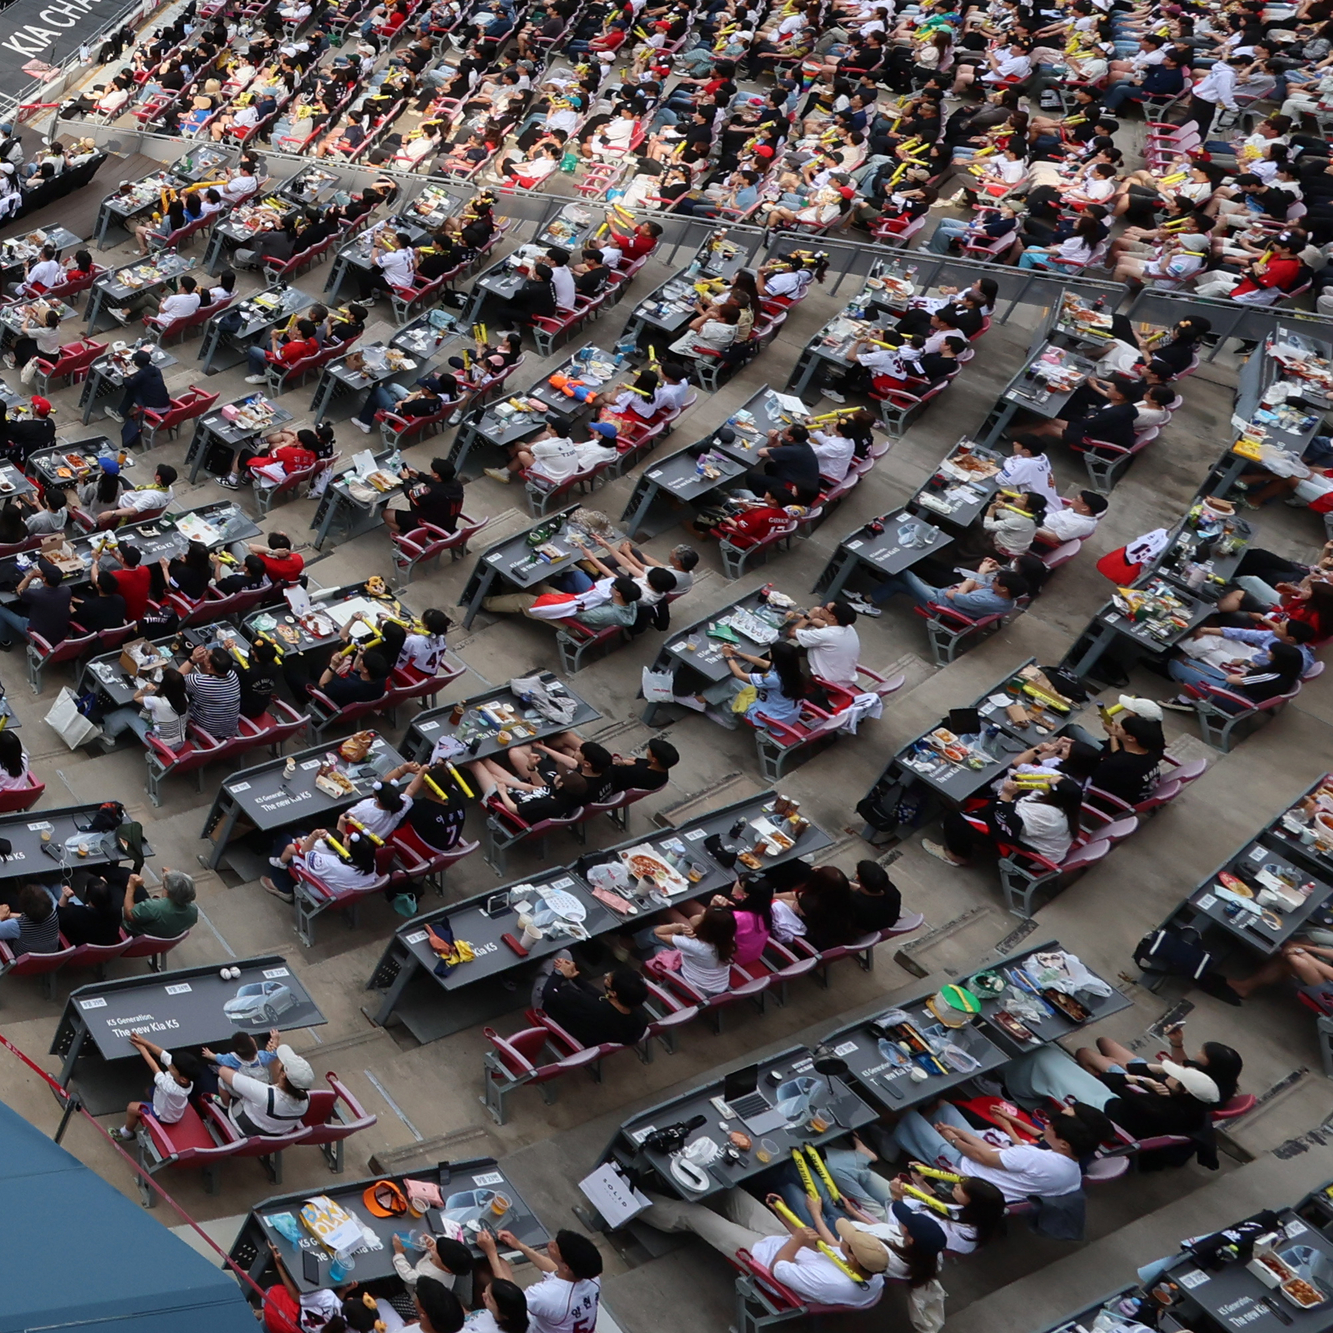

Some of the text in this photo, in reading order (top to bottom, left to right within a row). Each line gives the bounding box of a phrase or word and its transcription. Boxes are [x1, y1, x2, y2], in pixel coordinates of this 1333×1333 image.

[1, 21, 62, 59] KIA
[446, 824, 458, 846] 7
[485, 943, 499, 955] K5
[106, 1013, 155, 1027] K5 Generation,
[112, 1027, 132, 1039] The
[149, 1021, 166, 1032] Kia
[165, 1018, 181, 1030] K5
[602, 1177, 629, 1209] SOLID
